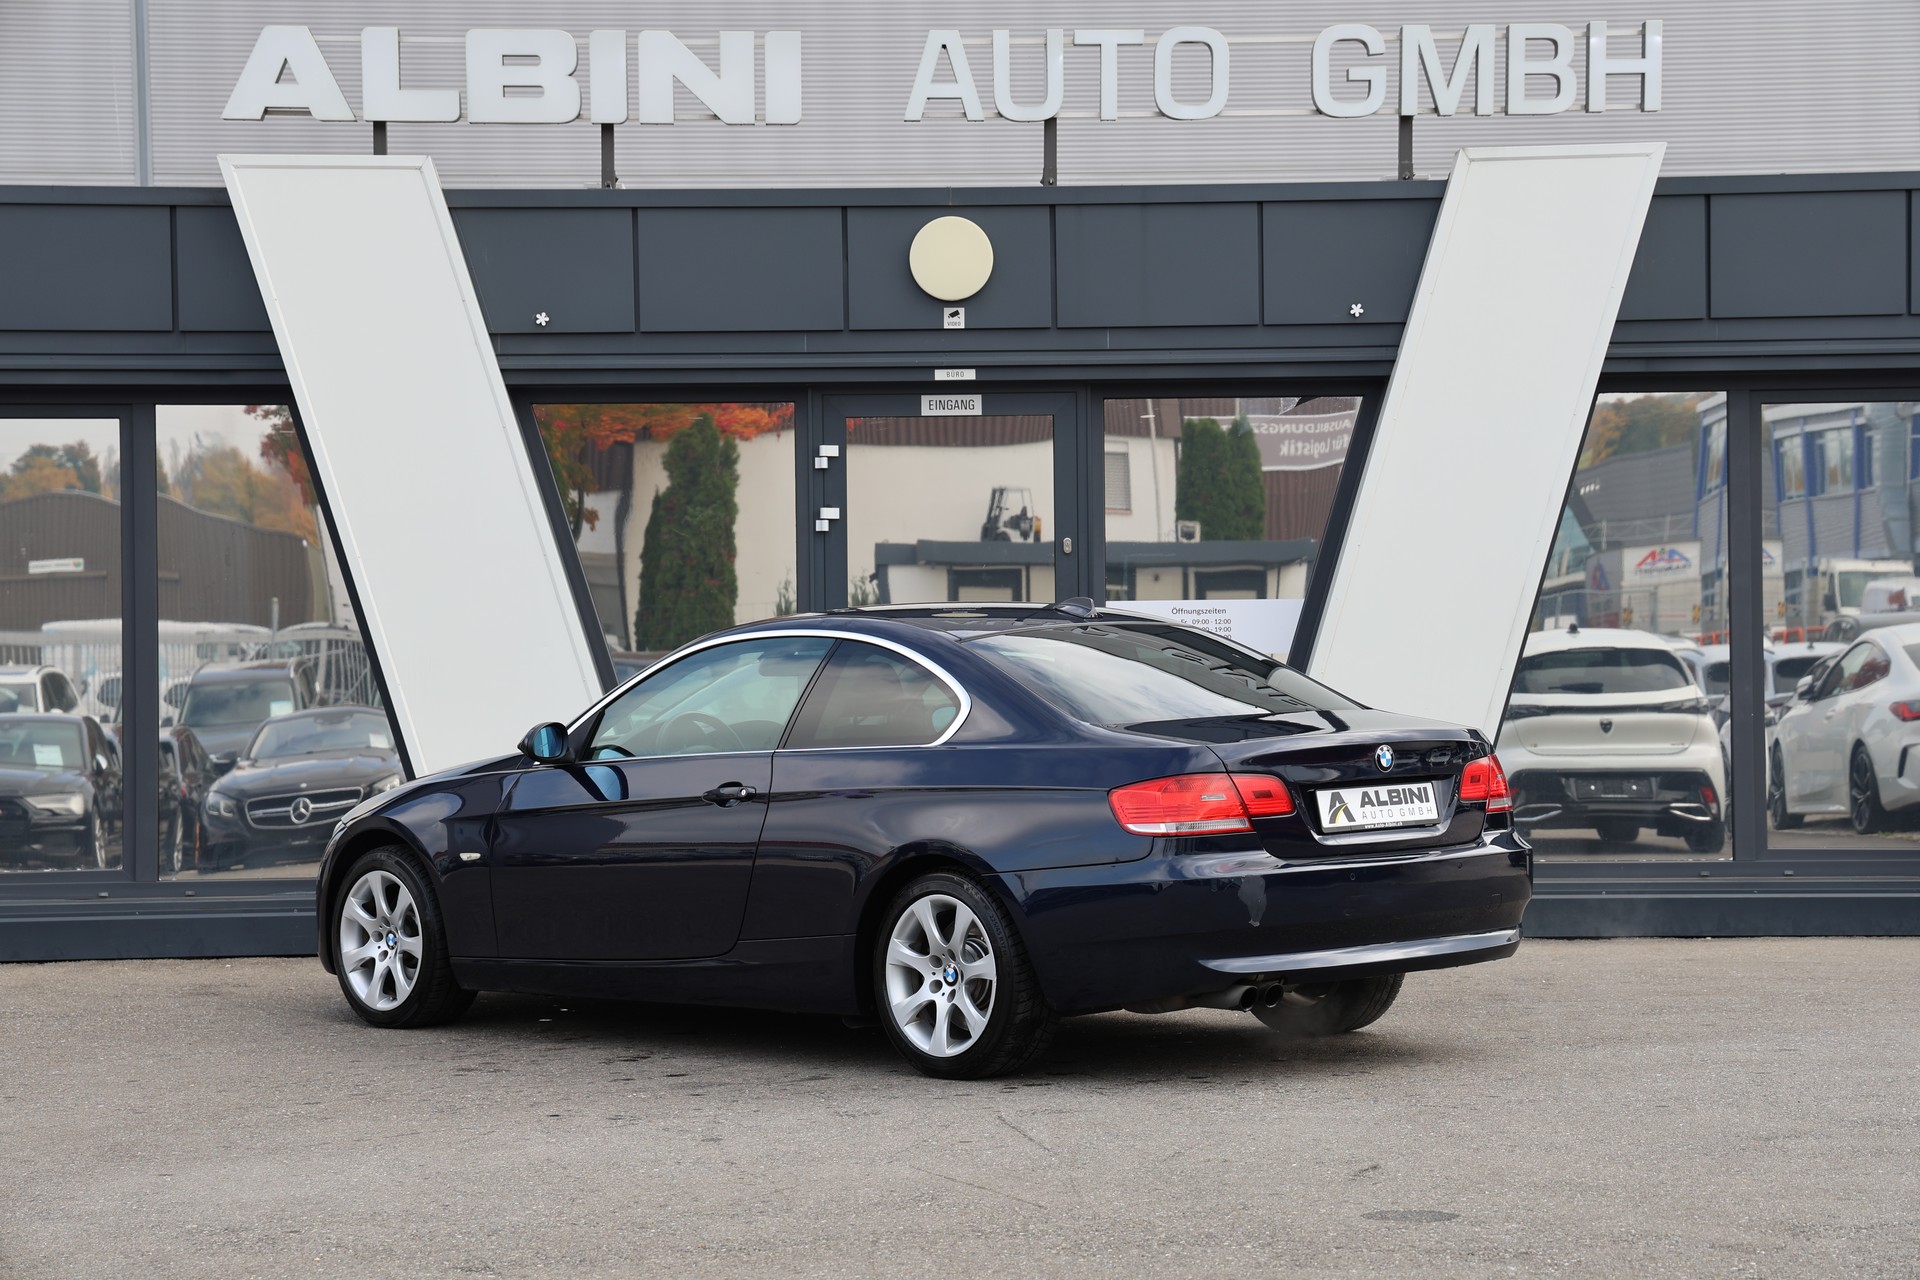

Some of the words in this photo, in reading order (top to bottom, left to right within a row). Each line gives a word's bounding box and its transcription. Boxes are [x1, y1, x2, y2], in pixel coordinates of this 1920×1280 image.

[221, 25, 802, 125] ALBINI
[904, 26, 1230, 122] AUTO
[1311, 20, 1663, 119] GMBH
[946, 370, 964, 378] BÜRO
[928, 399, 975, 411] EINGANG
[1171, 607, 1227, 616] Öffnungszeiten
[1360, 786, 1430, 808] ALBINI
[1362, 808, 1394, 820] AUTO
[1400, 806, 1433, 817] GMBH
